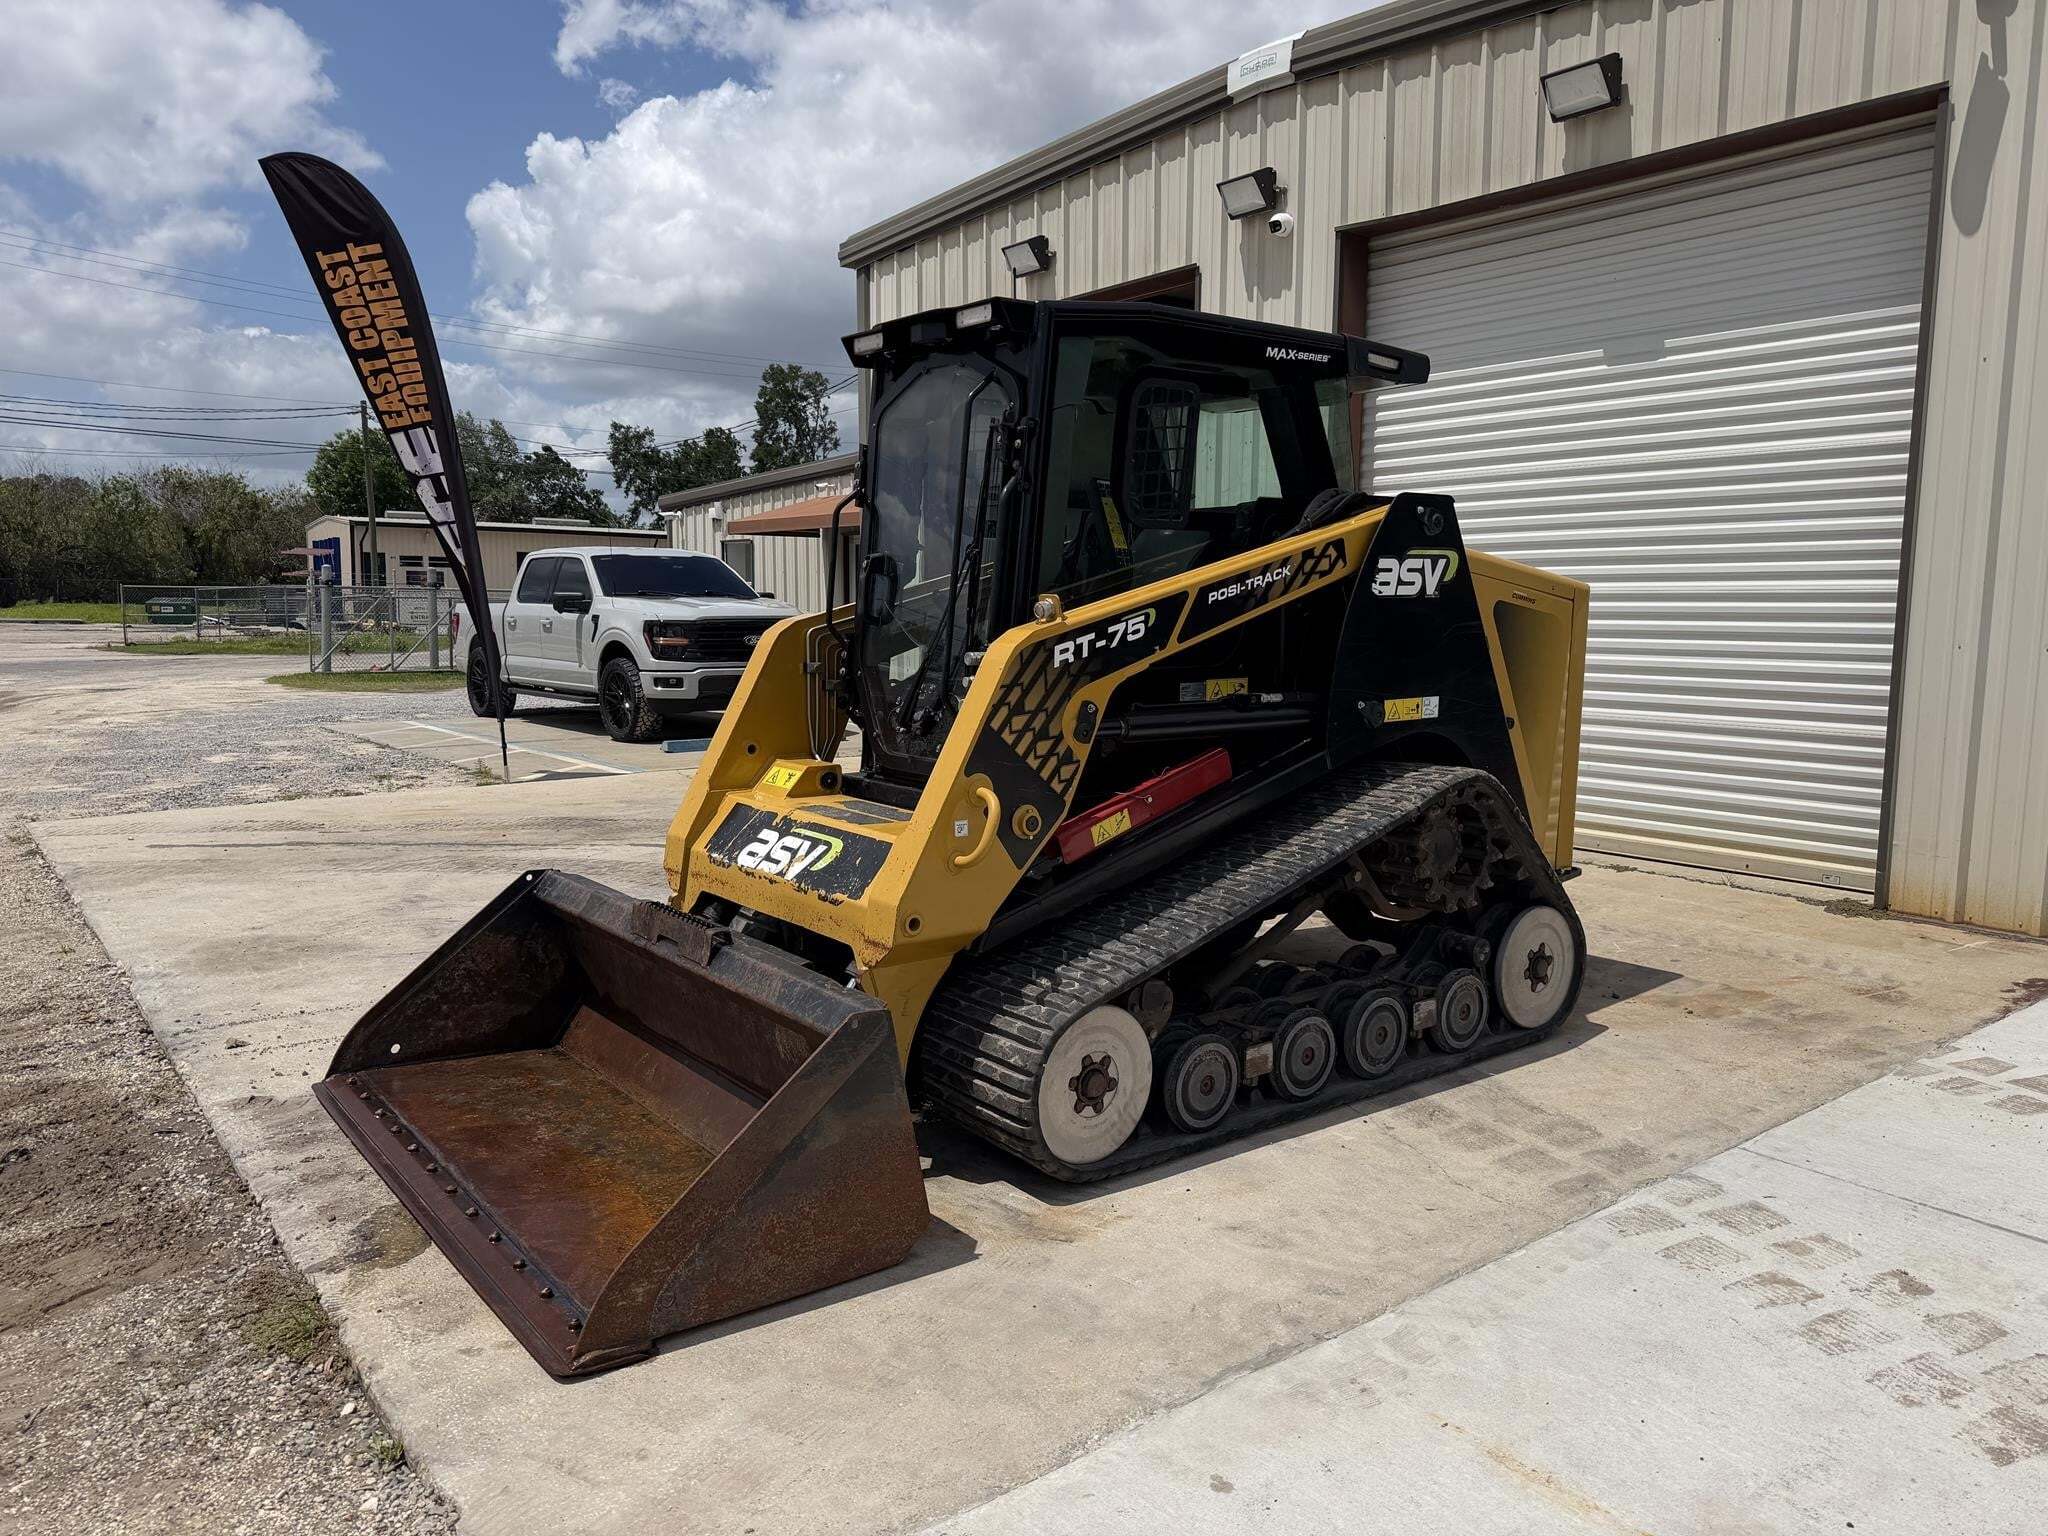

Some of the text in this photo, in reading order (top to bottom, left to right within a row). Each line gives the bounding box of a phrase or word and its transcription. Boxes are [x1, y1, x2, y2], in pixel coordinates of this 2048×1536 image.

[315, 249, 413, 429] EAST COAST
[346, 242, 433, 423] EQUIPMENT
[1053, 615, 1147, 668] RT-75
[1208, 565, 1291, 604] POSI-TRACK
